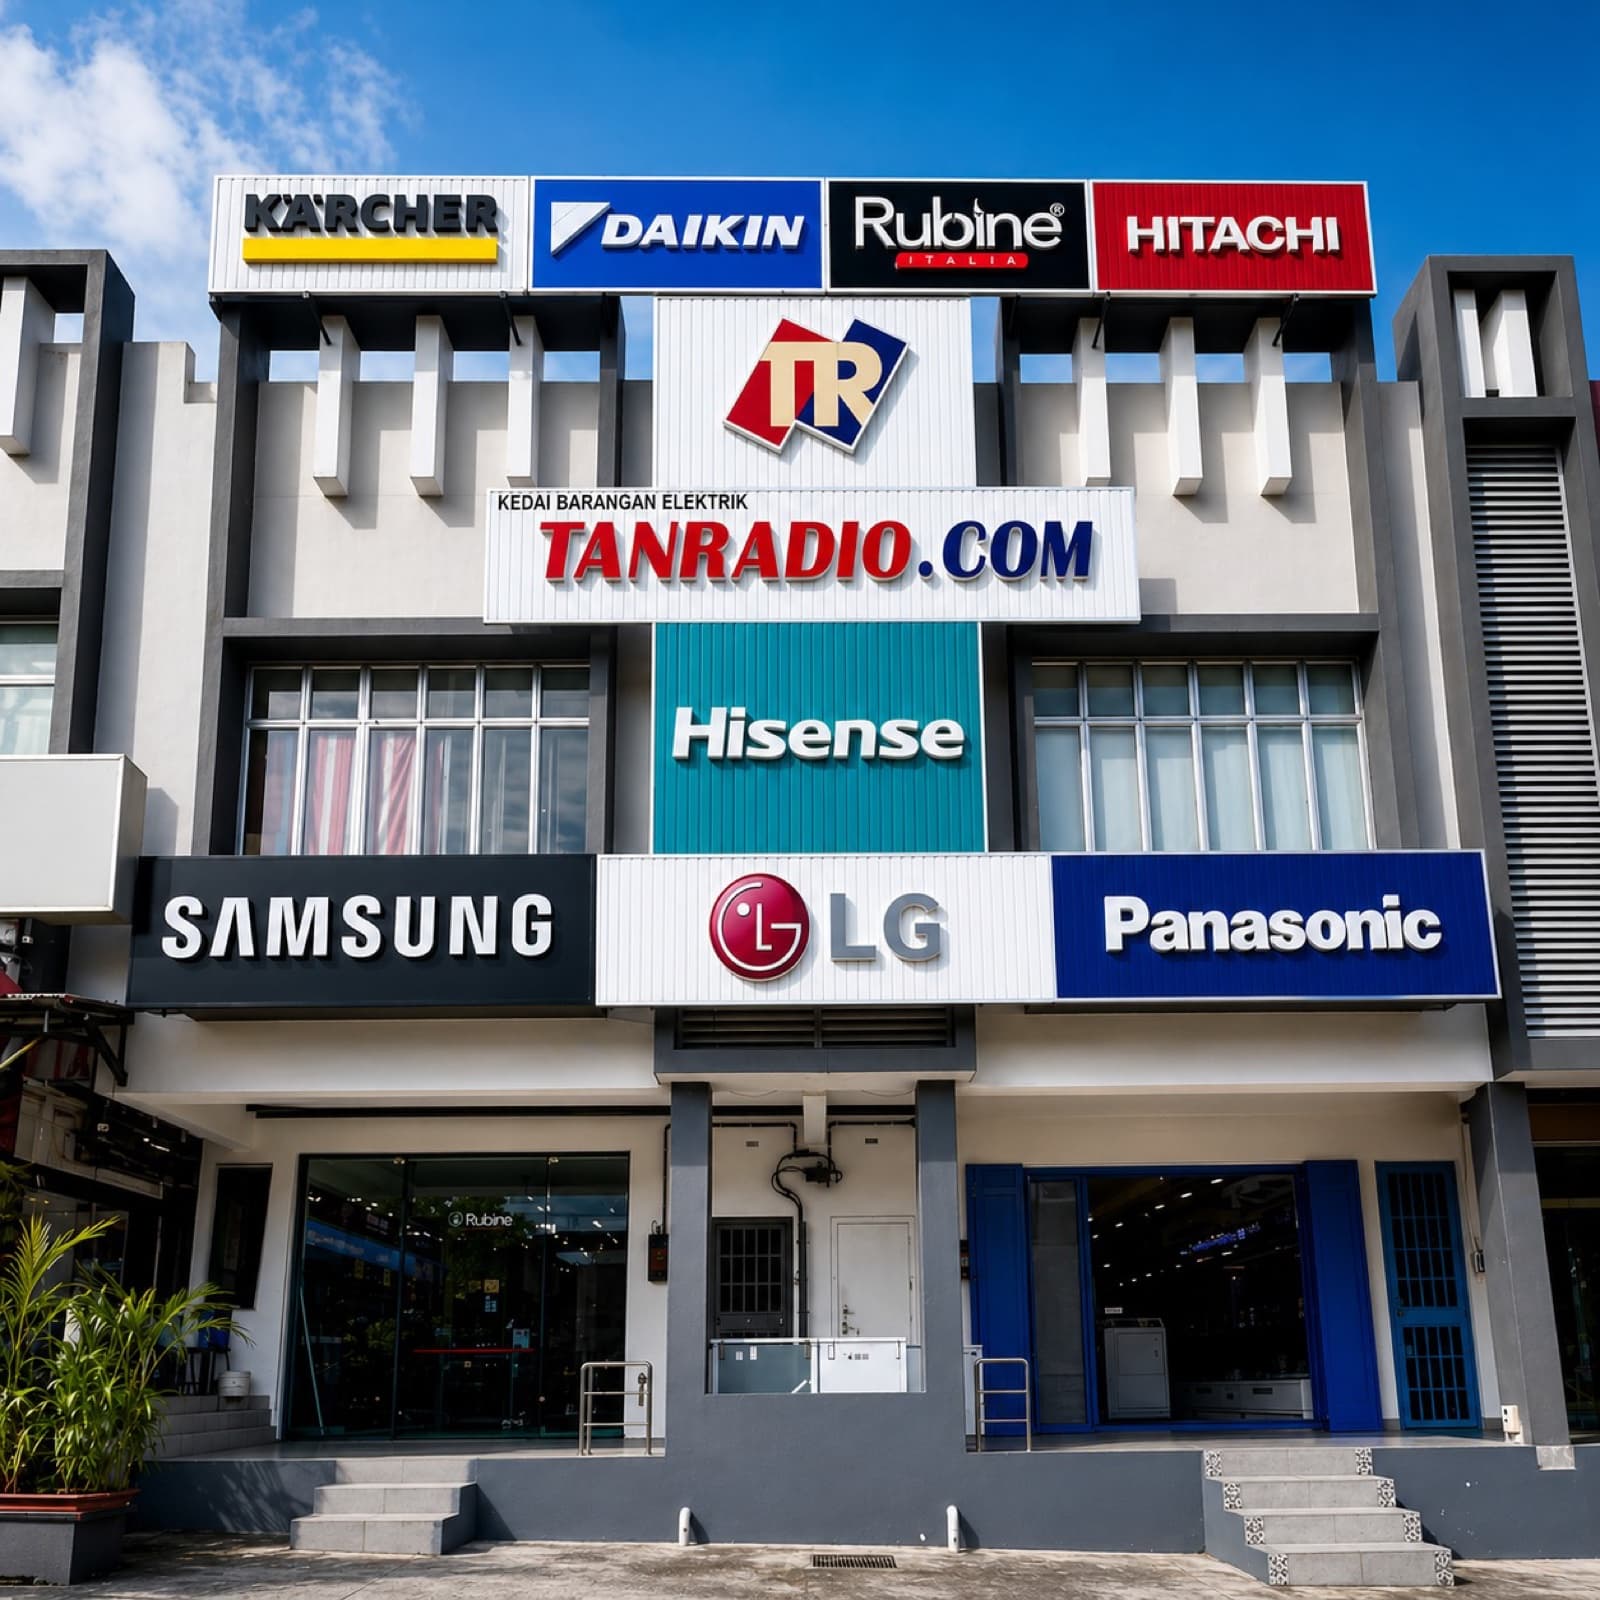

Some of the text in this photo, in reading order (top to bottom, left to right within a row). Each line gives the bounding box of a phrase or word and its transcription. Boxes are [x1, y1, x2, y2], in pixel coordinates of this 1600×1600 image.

[244, 193, 498, 234] KÄRCHER
[601, 214, 805, 249] DAIKIN
[1126, 216, 1341, 254] HITACHI
[908, 255, 1016, 265] ITALIA
[757, 341, 883, 427] TR
[498, 494, 748, 510] KEDAI BARANGAN ELEKTRIK
[540, 520, 1093, 583] TANRADIO.COM
[672, 706, 965, 760] Hisense
[161, 894, 554, 960] SAMSUNG
[830, 892, 941, 962] LG
[1103, 893, 1443, 953] Panasonic
[465, 1213, 513, 1227] Rubine
